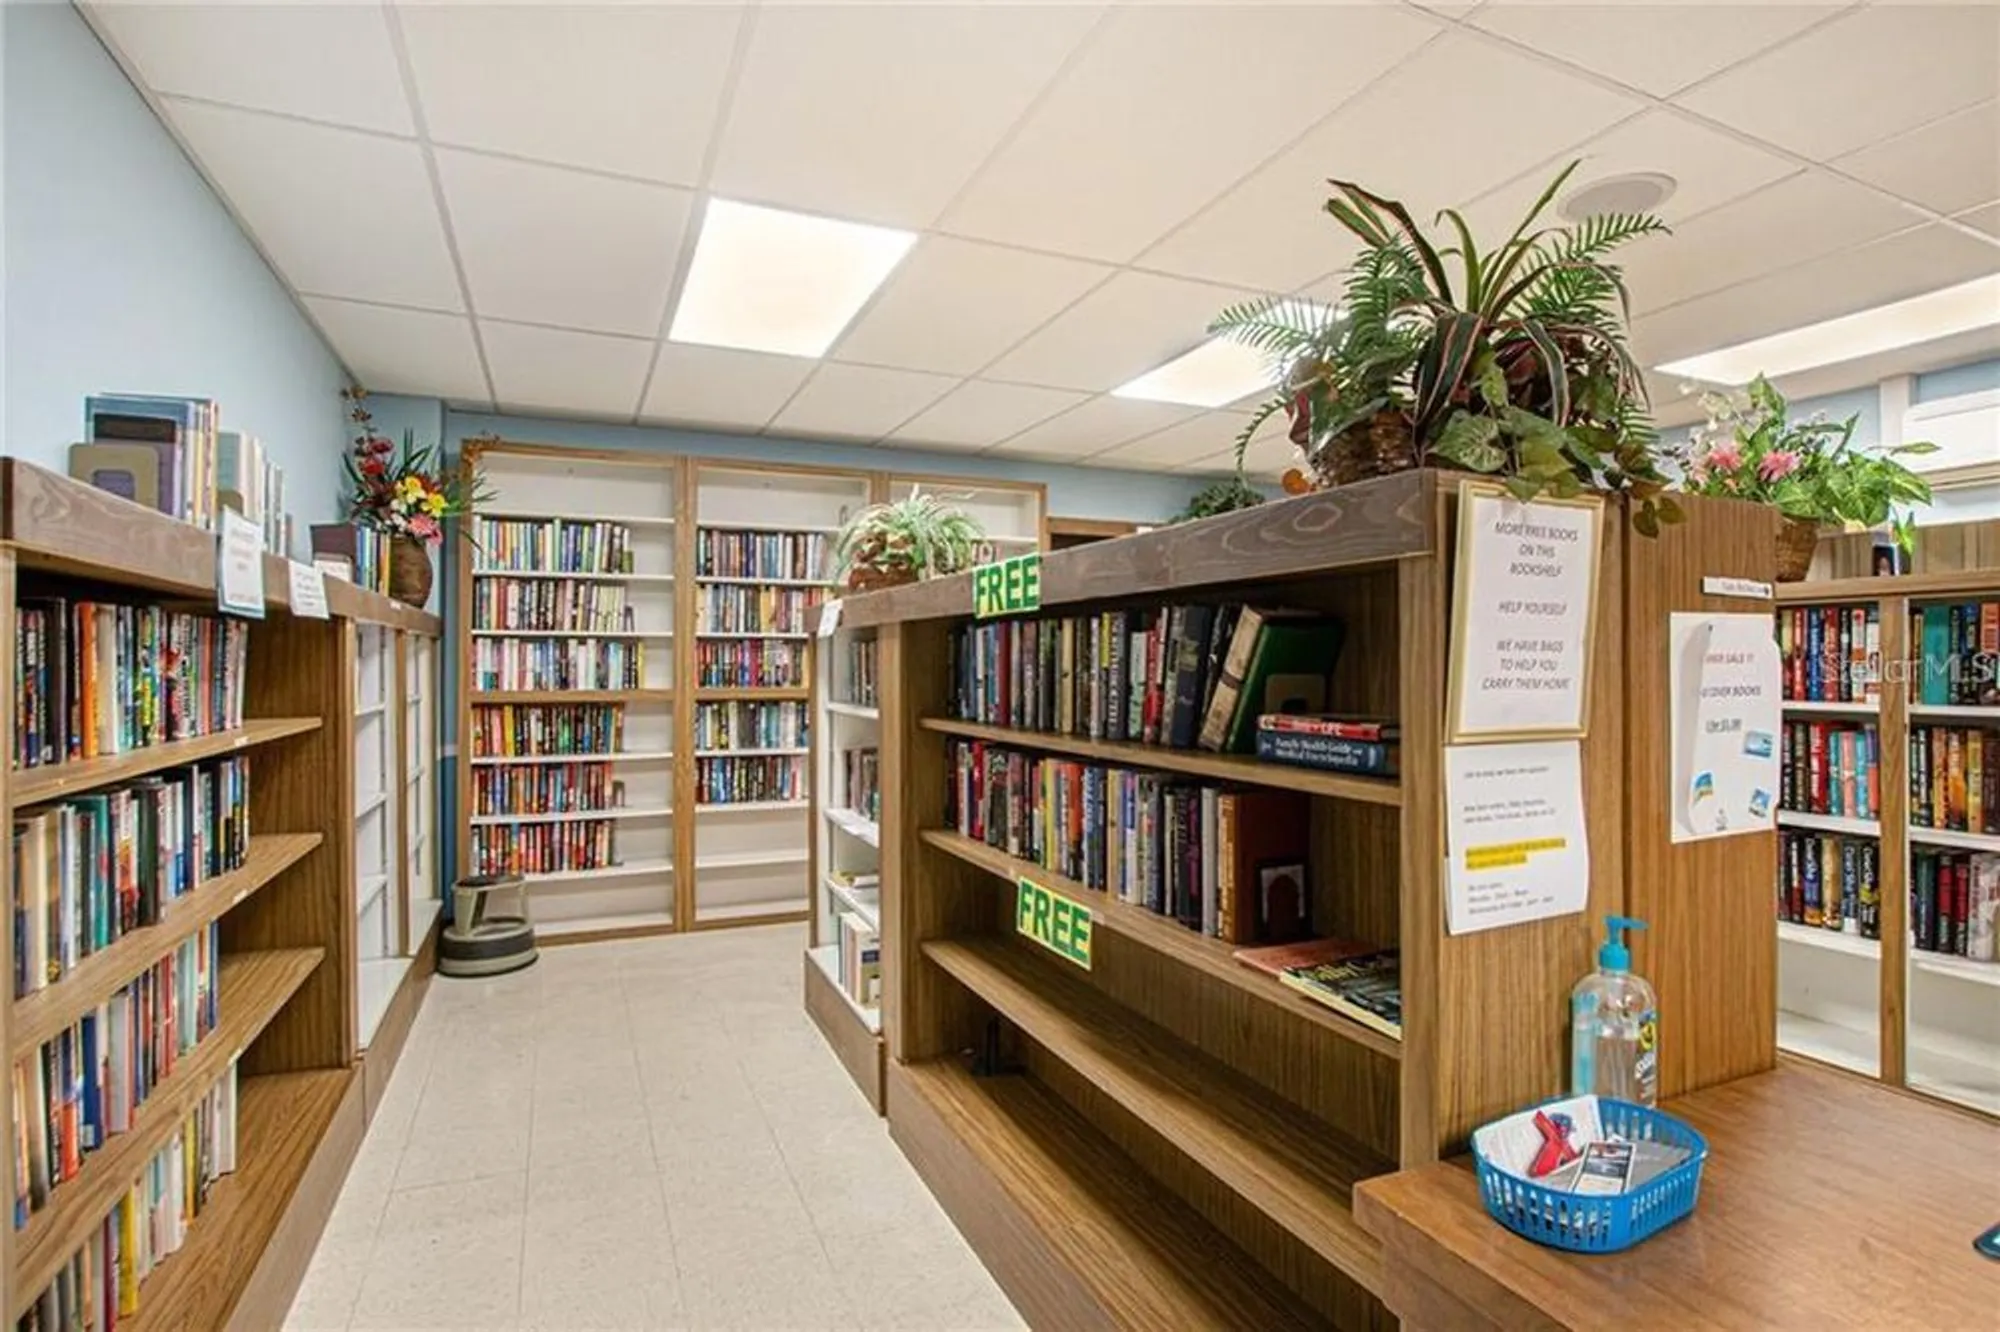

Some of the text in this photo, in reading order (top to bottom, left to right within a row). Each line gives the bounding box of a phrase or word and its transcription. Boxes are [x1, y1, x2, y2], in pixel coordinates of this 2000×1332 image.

[1495, 521, 1578, 542] MORE FREE BOOKS
[1519, 543, 1556, 558] ON THIS
[1510, 562, 1564, 578] BOOKSHELF
[975, 555, 1038, 615] FREE
[1498, 600, 1568, 616] HELP YOURSELF
[1496, 639, 1564, 654] WE HAVE BAGS
[1501, 658, 1559, 671] TO HELP YOU
[1726, 653, 1745, 664] SALE
[1482, 676, 1572, 690] CARRY THEM HOME
[1733, 685, 1762, 697] BOOKS
[1020, 881, 1090, 964] FREE
